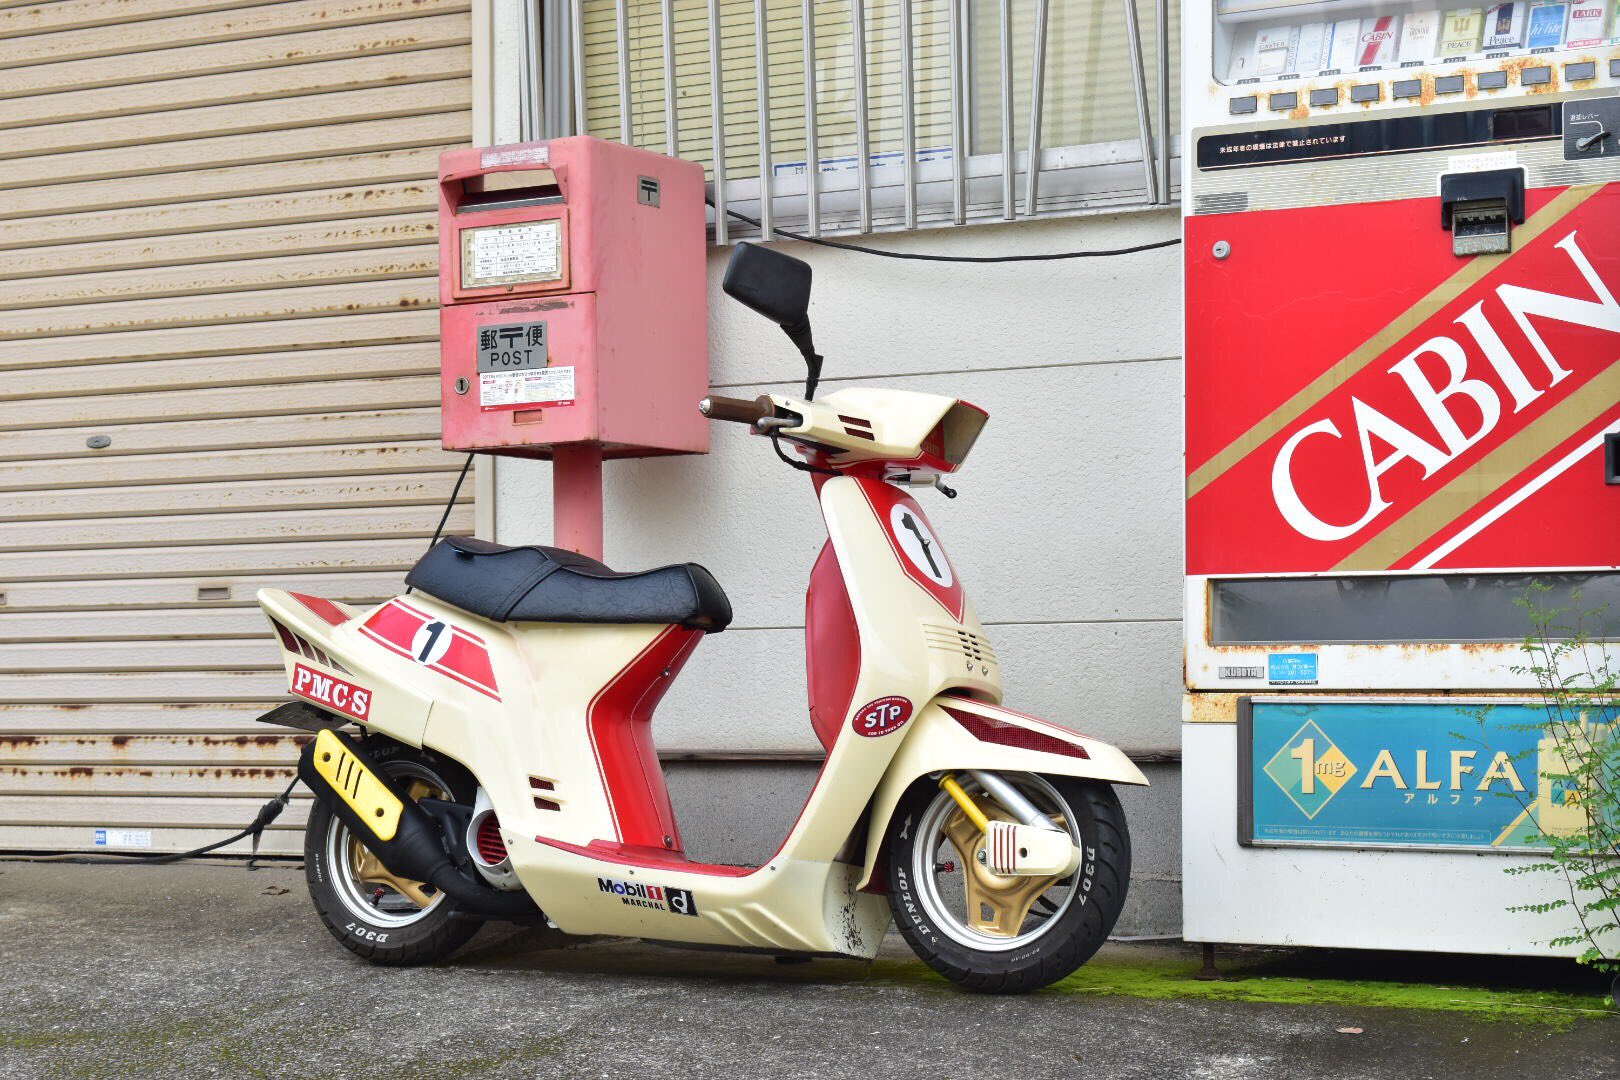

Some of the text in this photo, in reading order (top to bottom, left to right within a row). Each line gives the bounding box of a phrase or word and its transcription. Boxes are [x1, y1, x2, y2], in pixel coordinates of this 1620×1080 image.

[1575, 9, 1600, 18] LARK
[1361, 31, 1394, 43] CABIN
[1447, 41, 1473, 49] PEACE
[1488, 35, 1515, 46] Peace
[490, 349, 533, 367] POST
[1271, 230, 1620, 541] CABIN
[417, 621, 446, 663] 1
[1224, 667, 1258, 678] KUBOTA
[864, 703, 902, 728] STP
[1360, 749, 1527, 792] ALFA
[1403, 793, 1483, 806] アルファ
[1079, 846, 1096, 906] D307
[621, 897, 666, 911] MARCHAL
[897, 866, 932, 935] DUNLOP
[345, 922, 389, 943] D307
